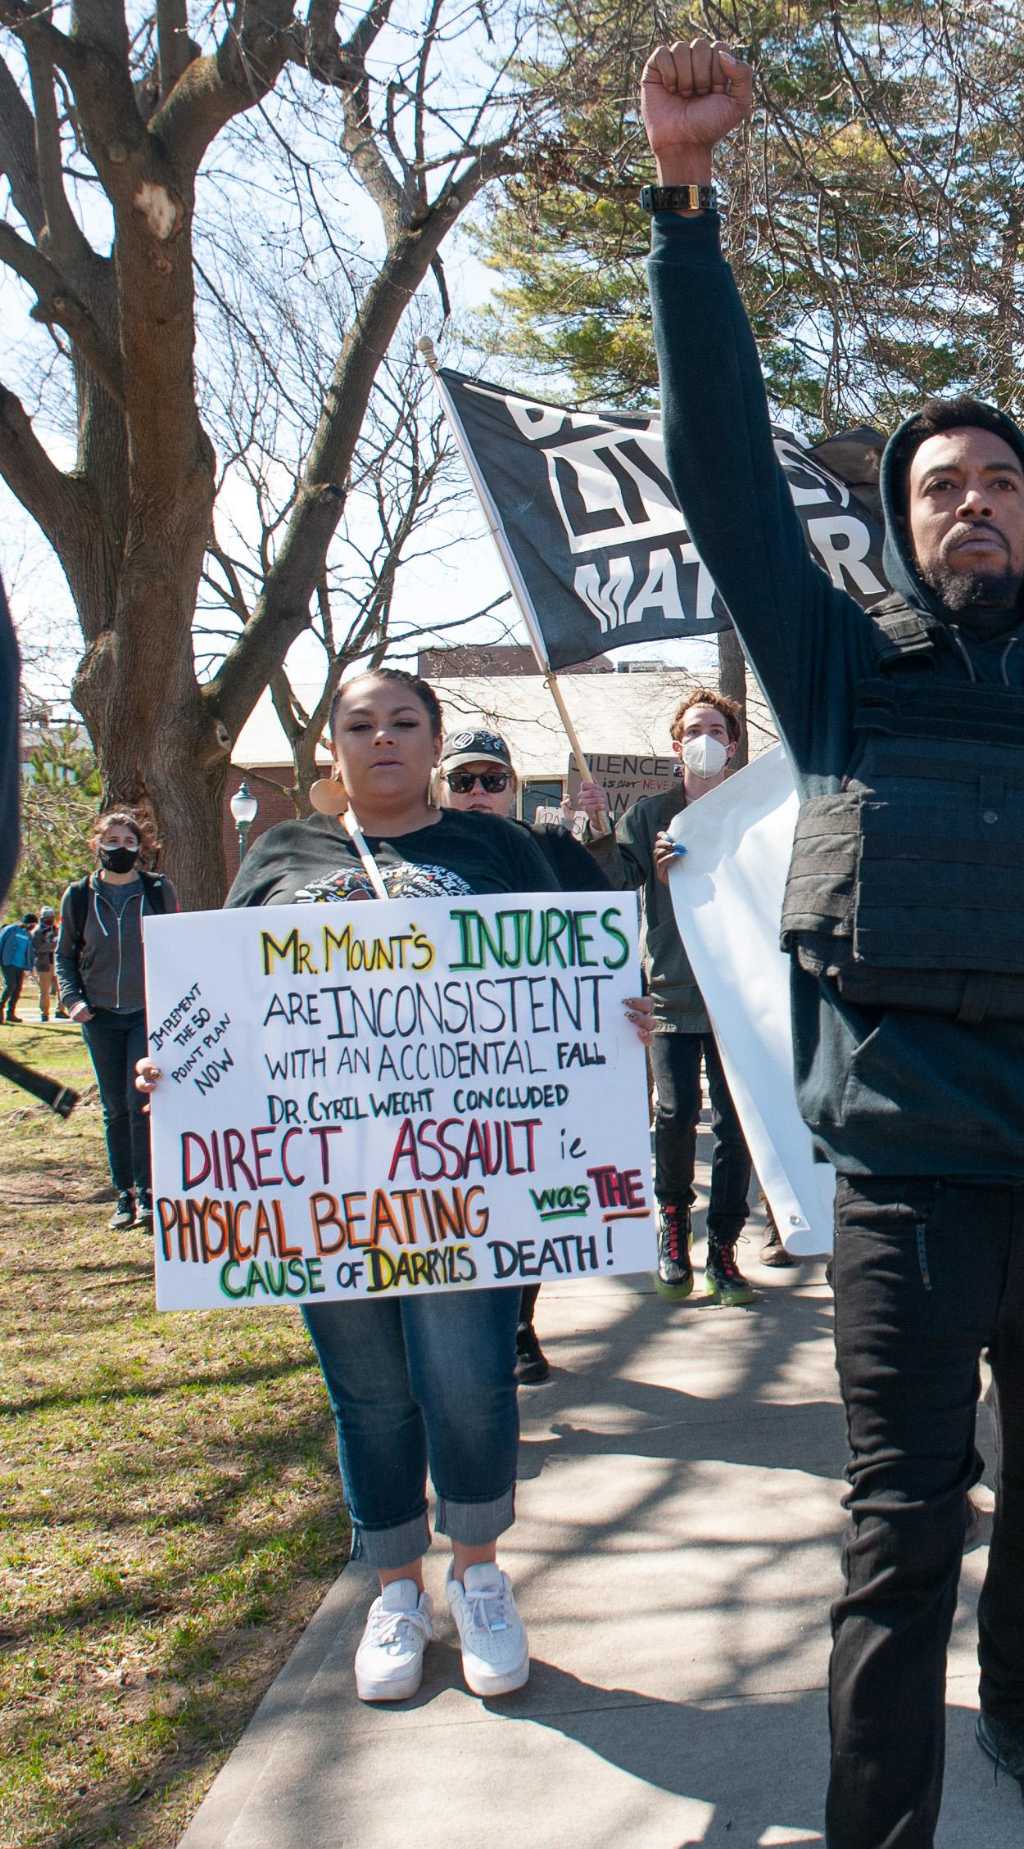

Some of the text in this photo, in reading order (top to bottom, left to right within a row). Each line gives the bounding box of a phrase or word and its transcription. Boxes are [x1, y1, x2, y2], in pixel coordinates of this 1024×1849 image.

[574, 515, 888, 634] MATR
[642, 777, 676, 791] NEVE
[325, 923, 434, 973] MOUNT'S
[449, 907, 630, 971] INJURIES
[148, 982, 202, 1051] IMPLEMENT
[173, 1007, 211, 1046] THE 50
[263, 975, 613, 1040] ARE INCONSISTENT
[171, 1013, 231, 1084] POINT PLAN
[194, 1048, 235, 1096] NOW
[265, 1040, 606, 1081] WITH AN ACCIDENTAL FALL
[308, 1092, 367, 1124] CYRIL
[371, 1089, 434, 1117] WECHT
[454, 1085, 569, 1113] CONCLUDED
[181, 1119, 587, 1192] DIRECT ASSAULT ie
[157, 1166, 646, 1263] PHYSICAL BEATING was THE
[220, 1257, 326, 1300] CAUSE
[336, 1263, 364, 1290] OF
